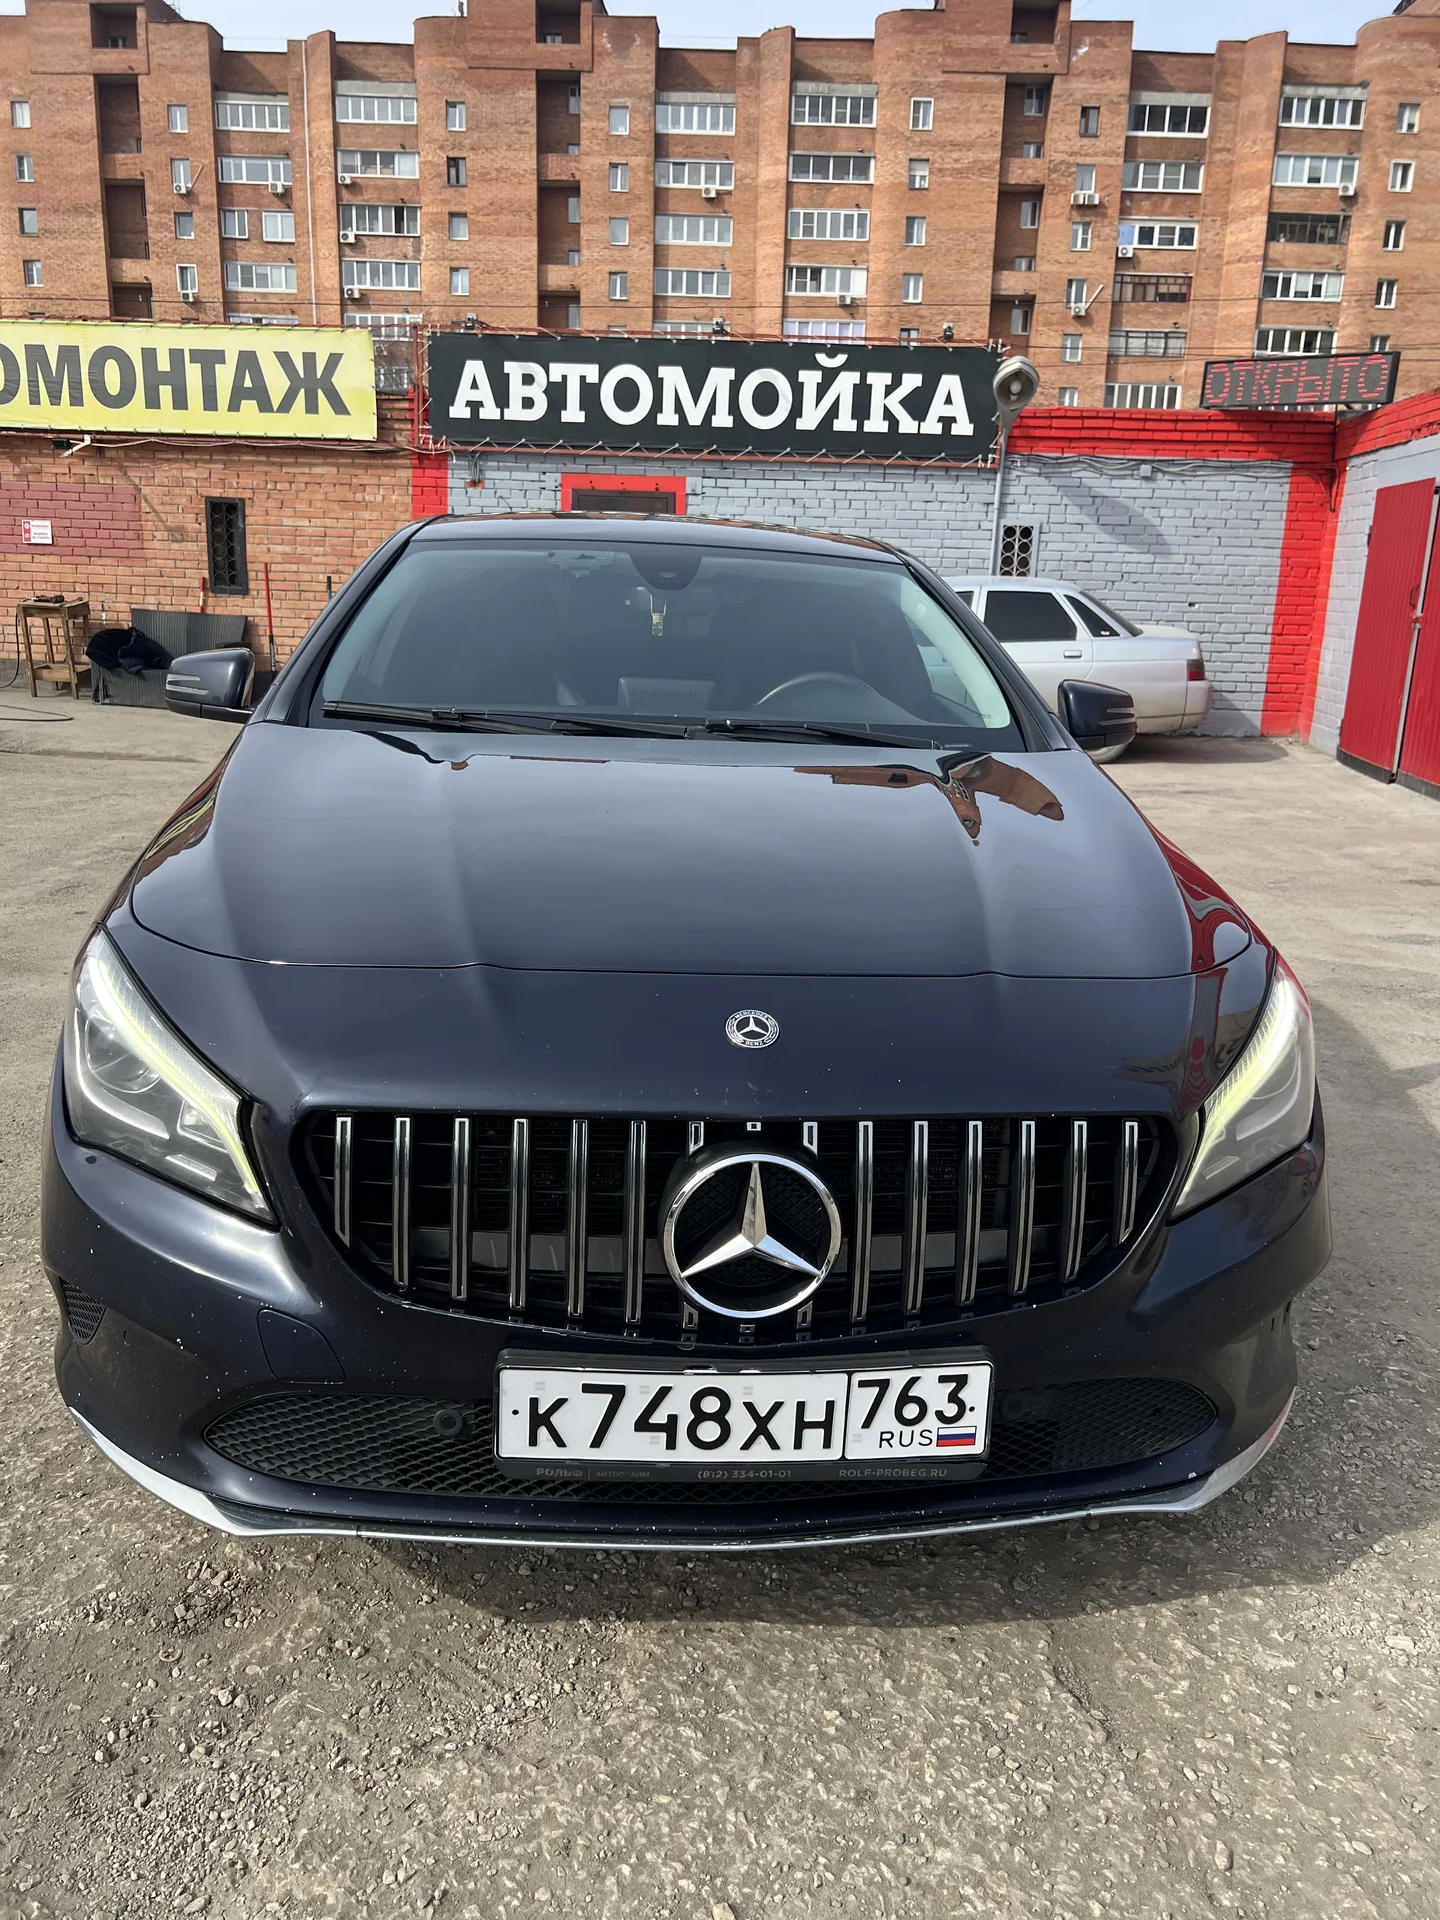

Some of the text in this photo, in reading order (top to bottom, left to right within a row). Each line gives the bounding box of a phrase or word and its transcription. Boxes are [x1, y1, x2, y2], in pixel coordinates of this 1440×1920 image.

[1205, 354, 1389, 404] ОТКРЫТО
[448, 353, 974, 437] АВТОМОЙКА
[857, 1374, 969, 1429] 763
[879, 1428, 933, 1449] RUS
[536, 1467, 650, 1478] РОЛЬФ АВТОПАЙМ
[697, 1469, 791, 1479] (812) 334-01-01
[839, 1468, 947, 1479] ROLF-PROBEG.RU
